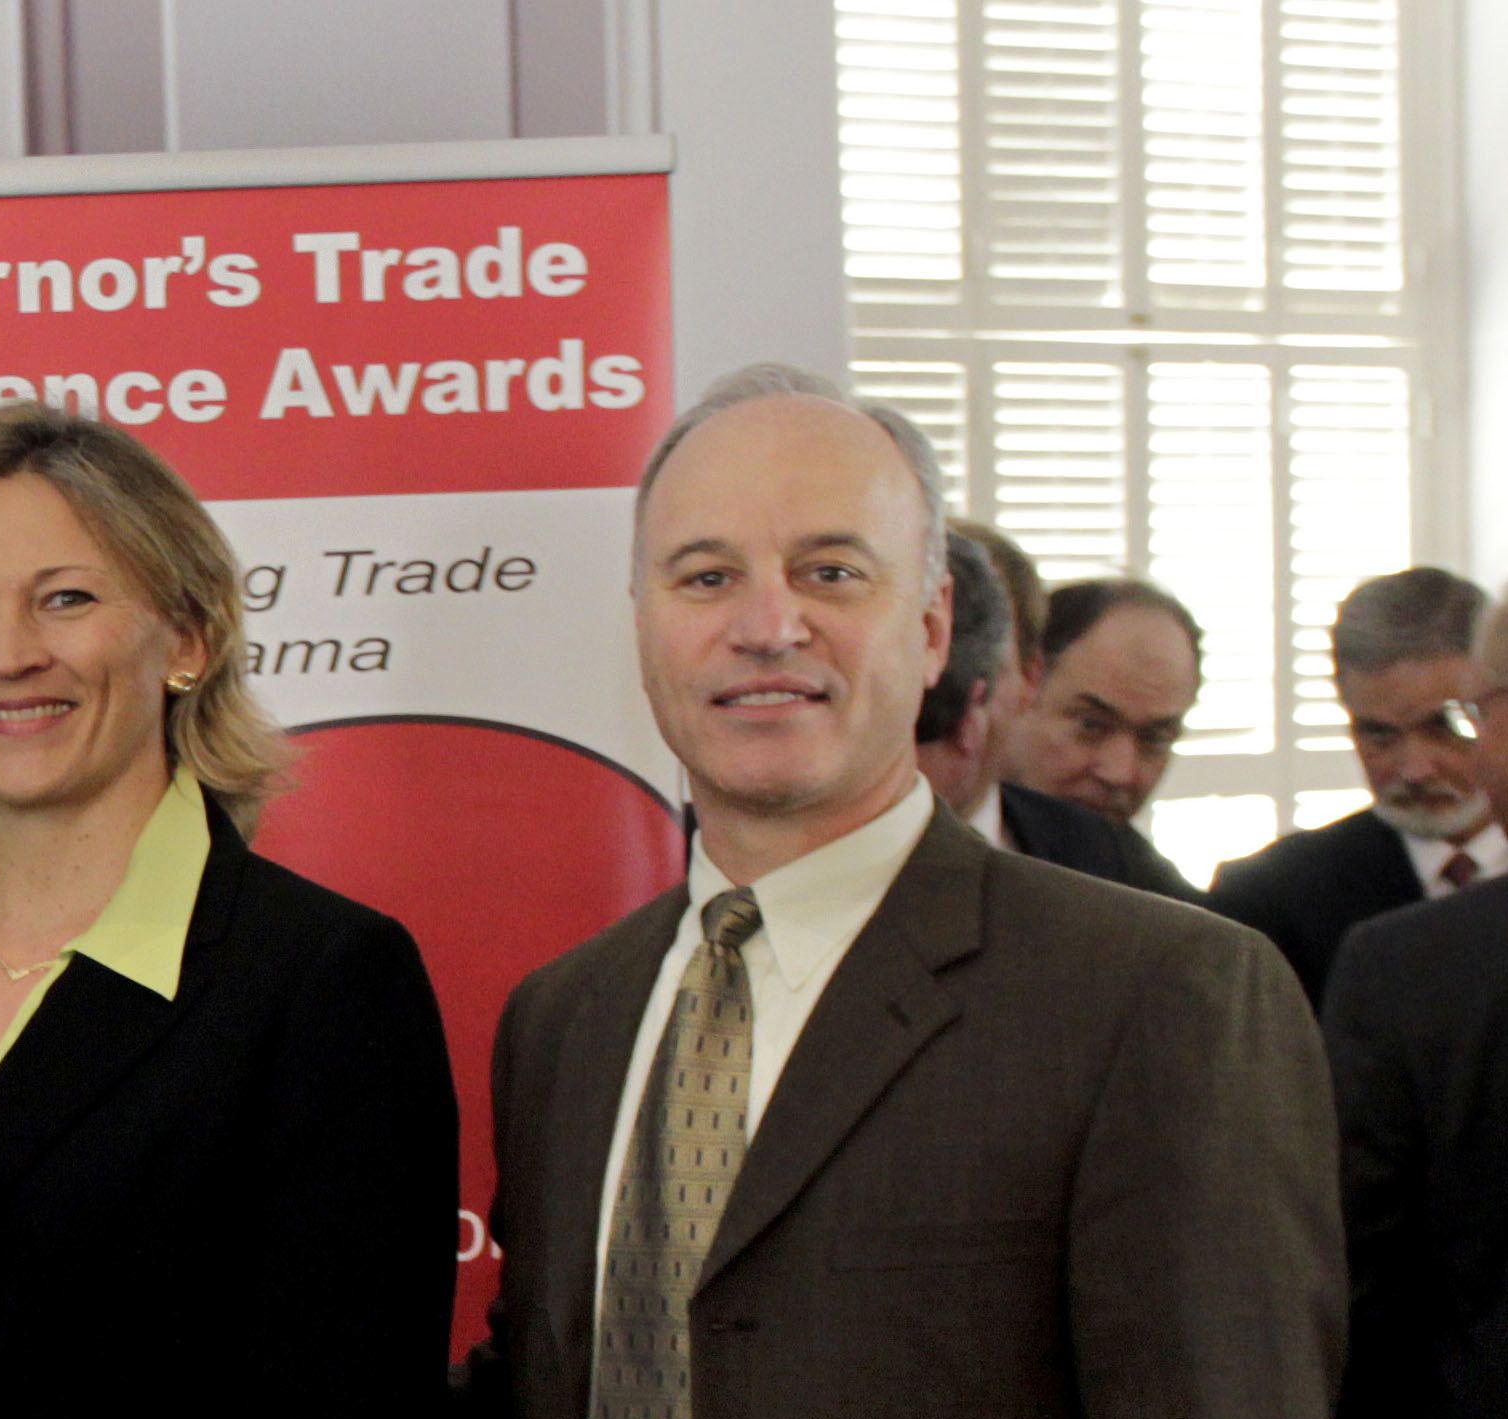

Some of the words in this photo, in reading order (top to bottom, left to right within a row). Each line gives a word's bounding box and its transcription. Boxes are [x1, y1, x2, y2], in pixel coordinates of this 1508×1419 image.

[292, 226, 588, 304] Trade
[259, 339, 646, 420] Awards
[323, 546, 537, 597] Trade
